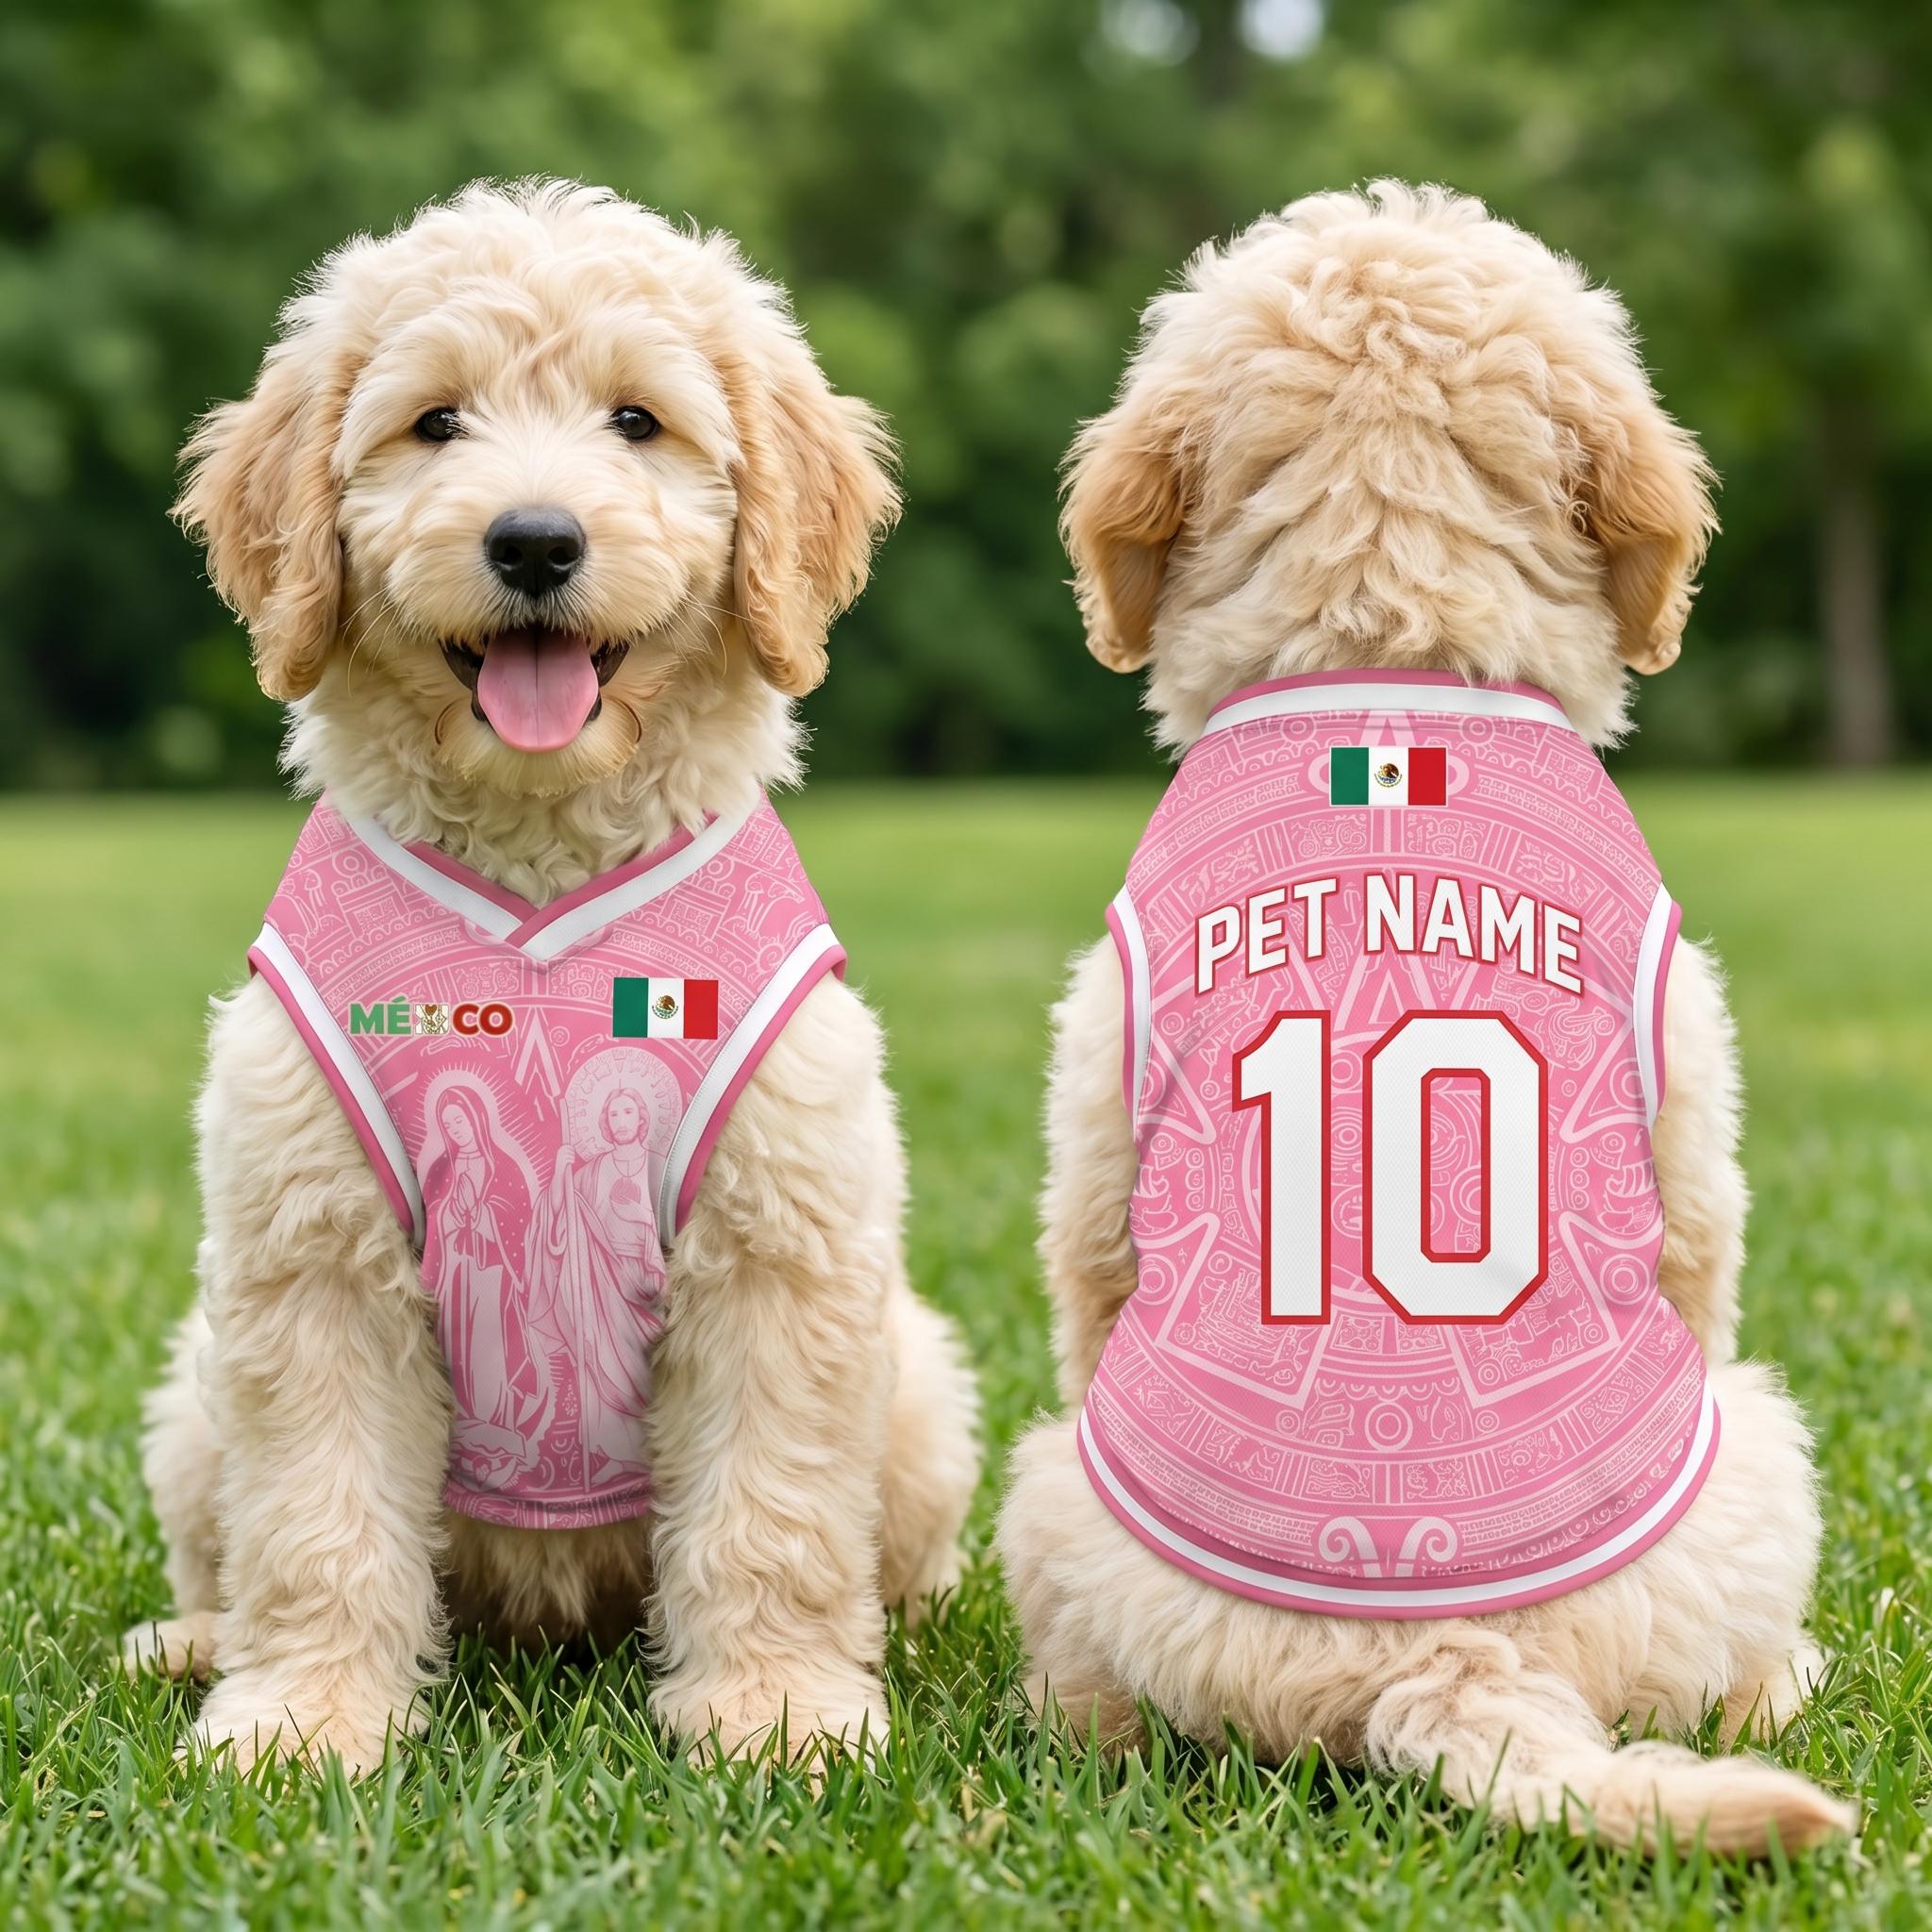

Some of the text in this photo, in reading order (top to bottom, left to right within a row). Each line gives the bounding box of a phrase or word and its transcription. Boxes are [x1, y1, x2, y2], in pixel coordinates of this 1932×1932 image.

[1195, 872, 1584, 997] PET NAME
[1232, 1009, 1548, 1324] 10
